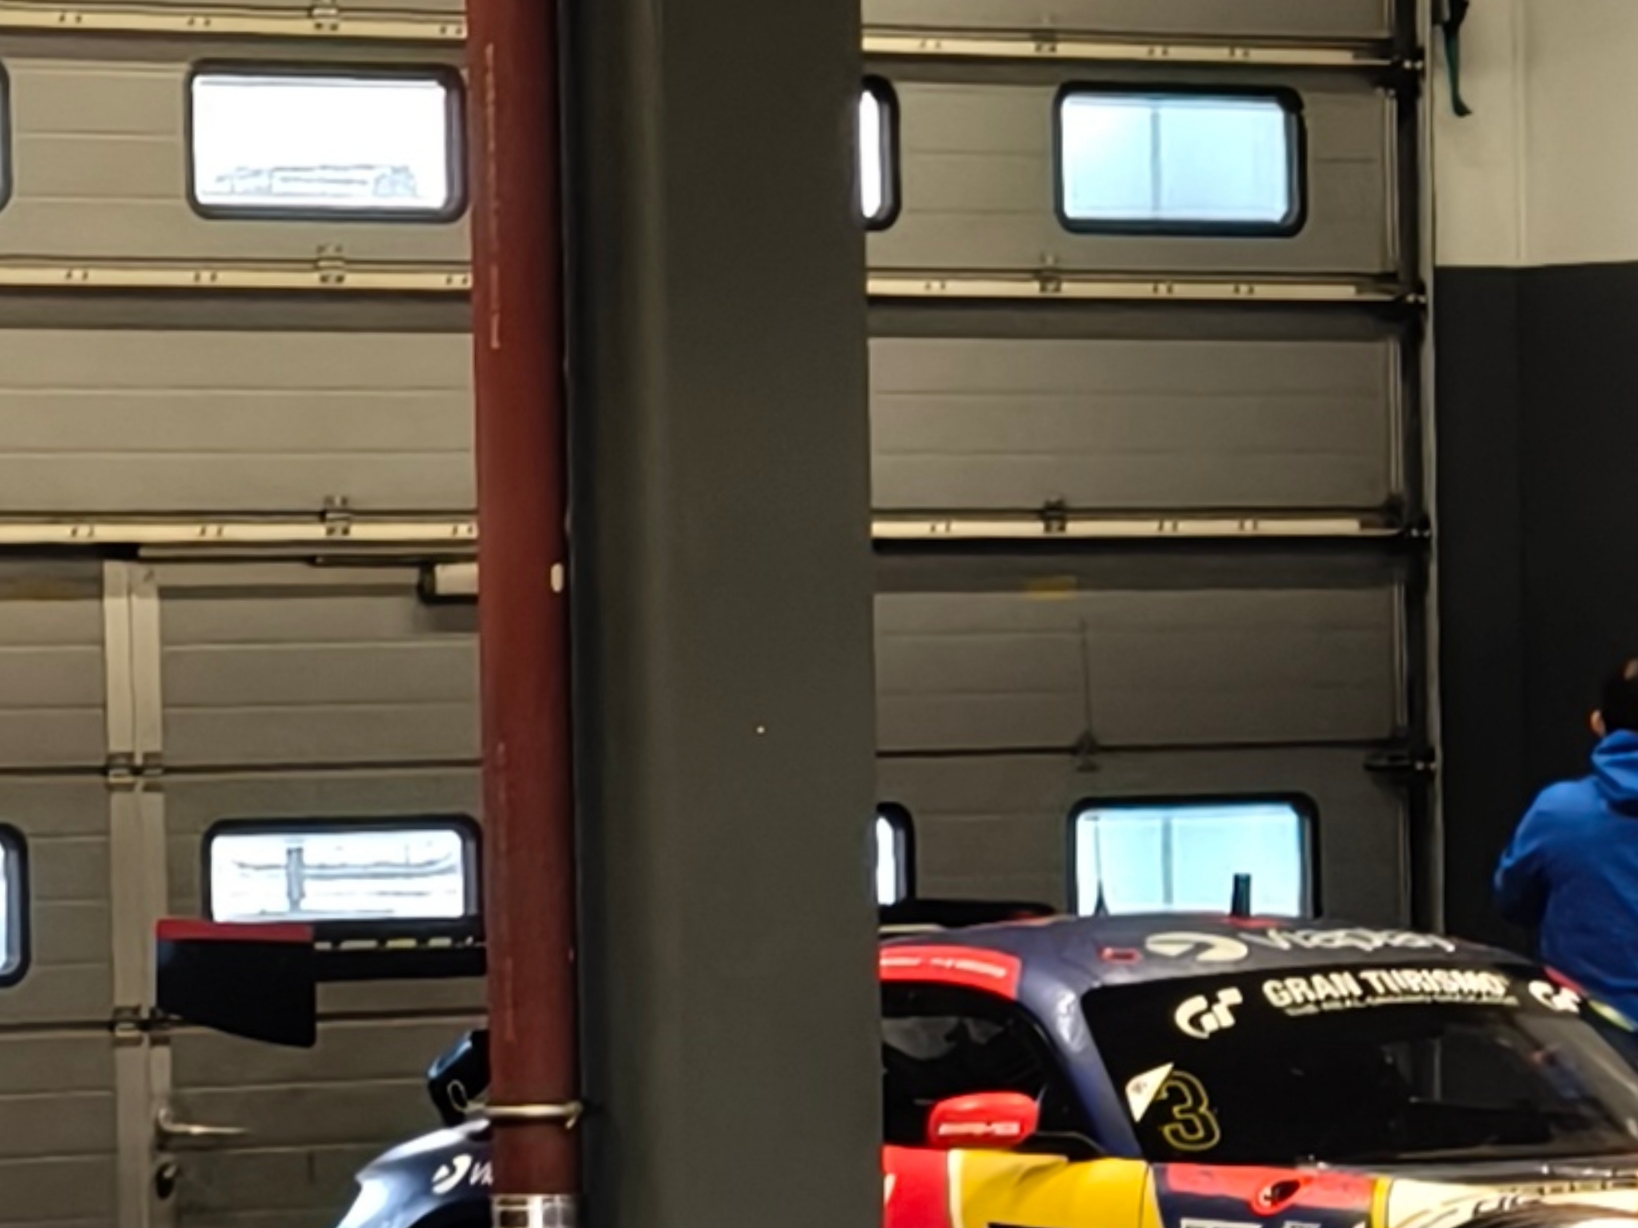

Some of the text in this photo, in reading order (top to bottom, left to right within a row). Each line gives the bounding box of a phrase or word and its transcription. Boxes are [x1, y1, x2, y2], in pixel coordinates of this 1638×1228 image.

[1262, 971, 1362, 1007] GRAN
[1358, 968, 1507, 996] TURISMO
[1156, 1070, 1221, 1151] 3
